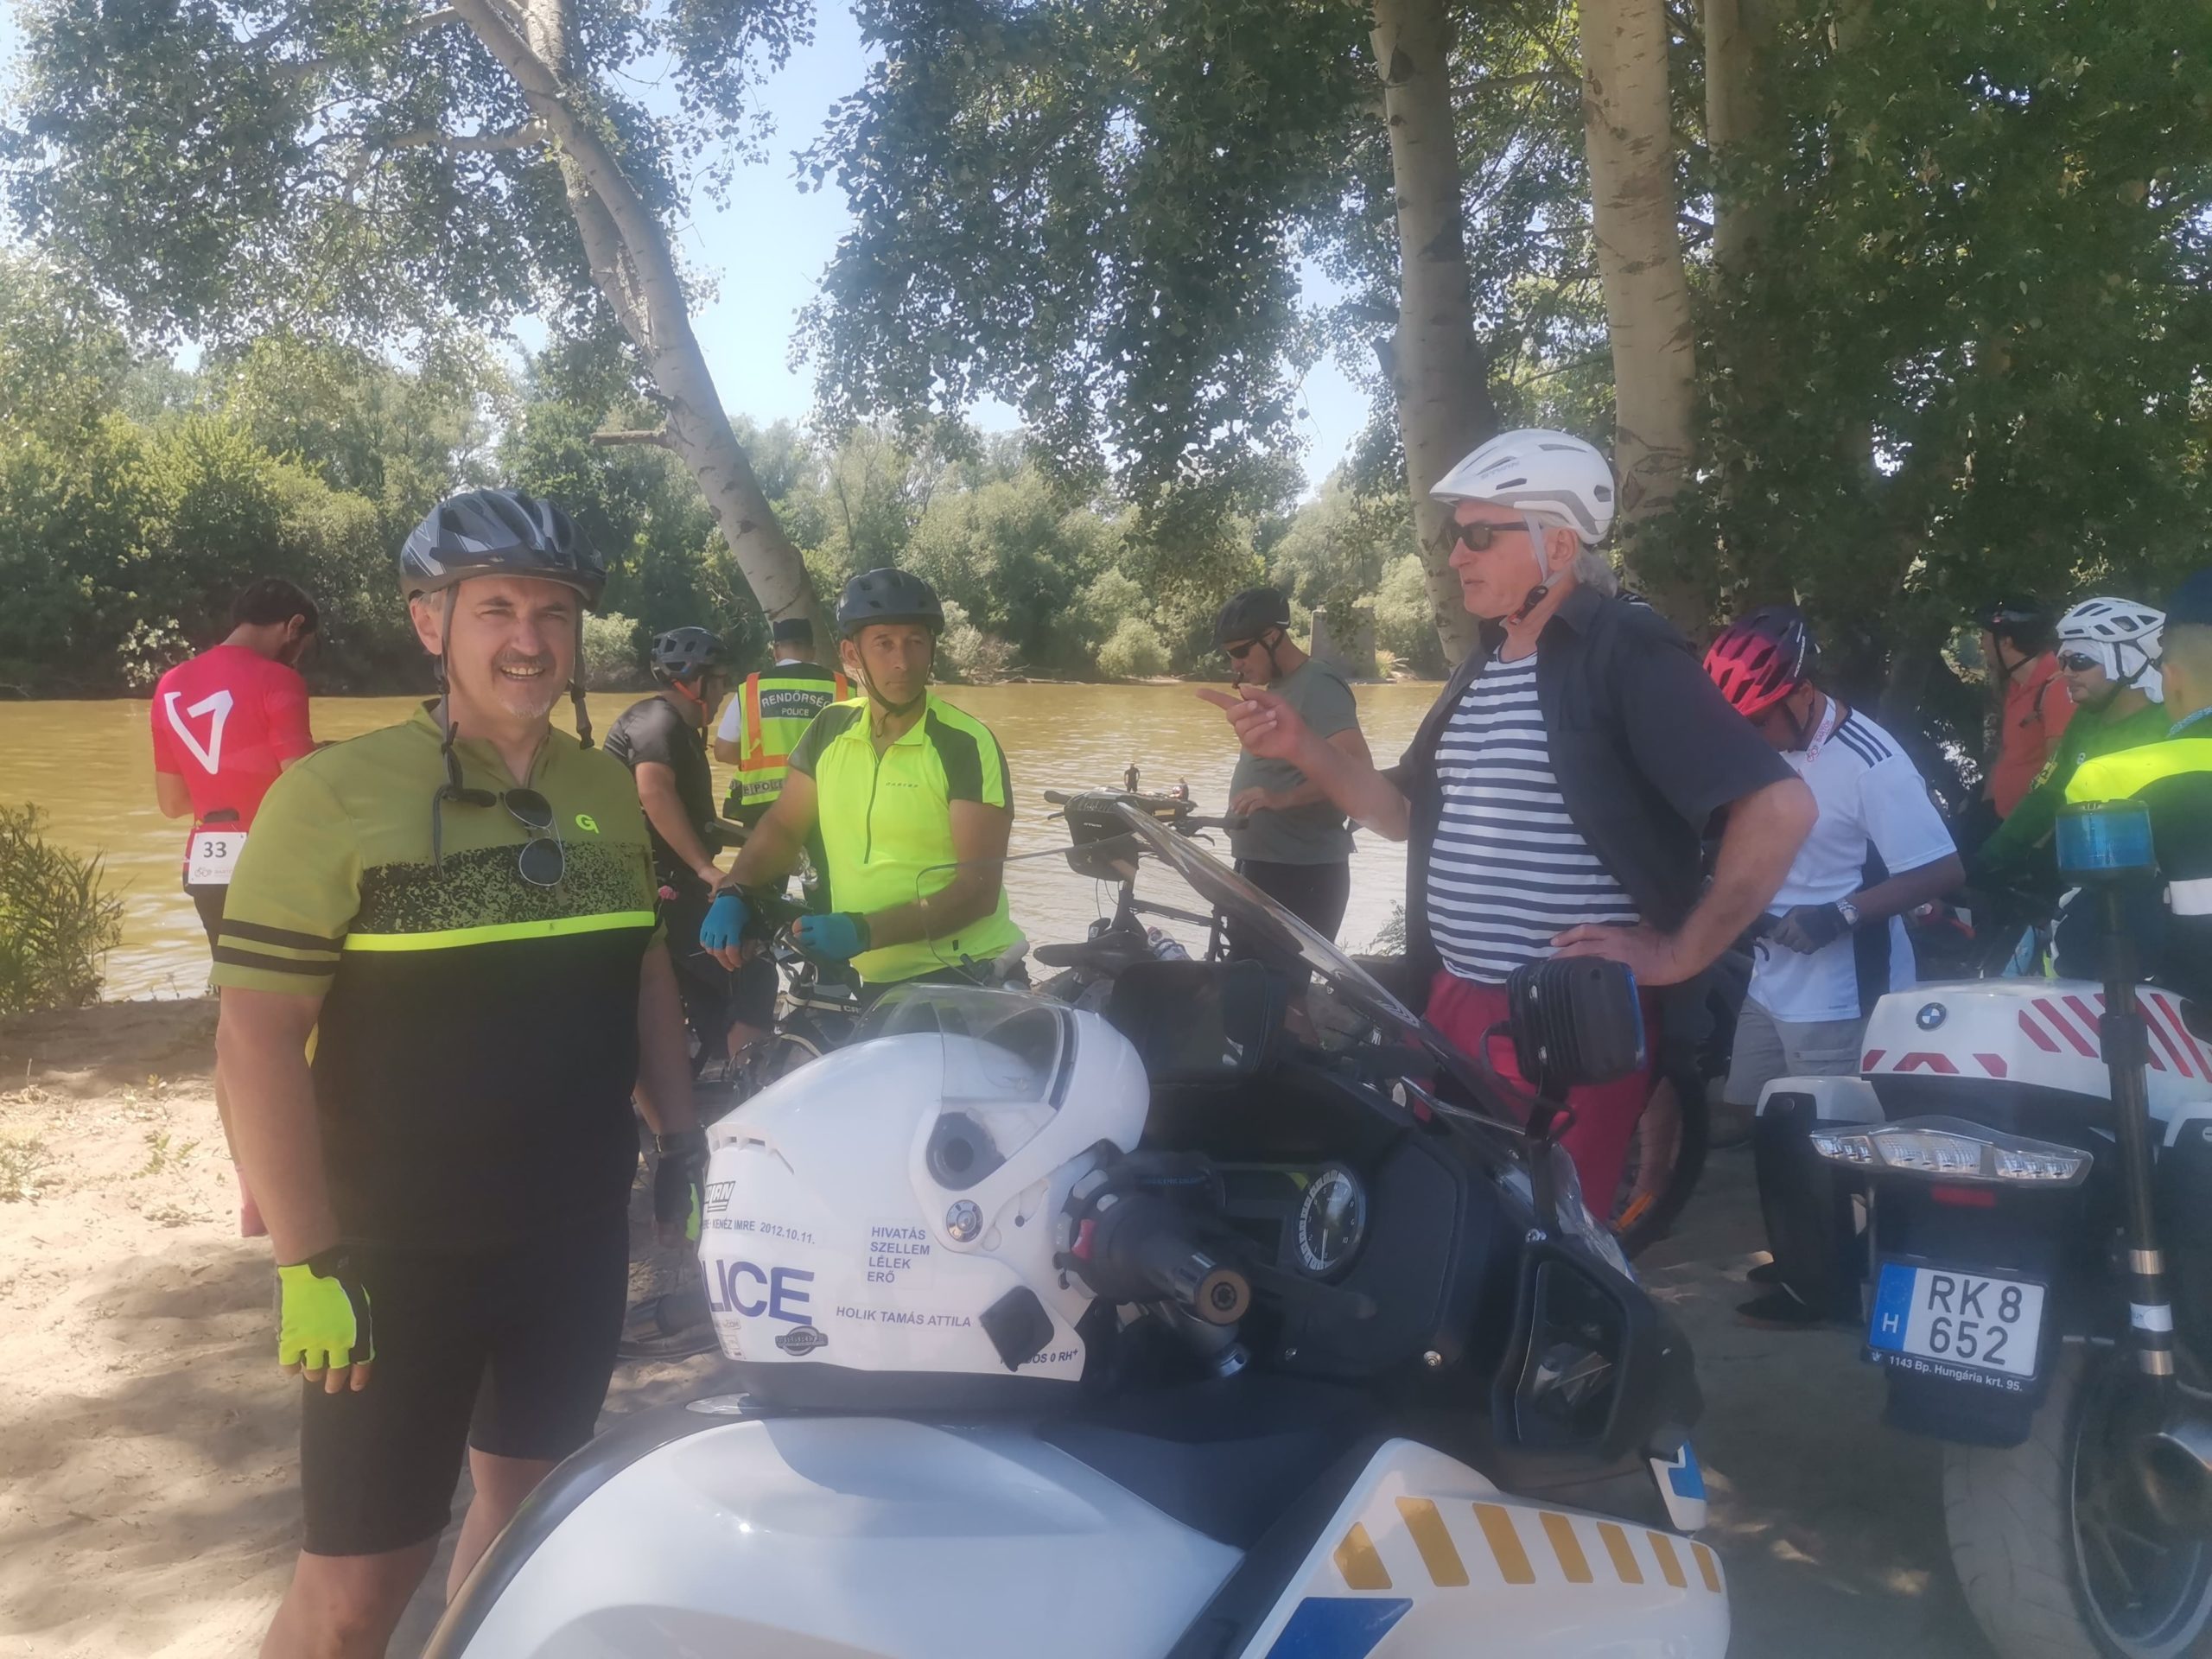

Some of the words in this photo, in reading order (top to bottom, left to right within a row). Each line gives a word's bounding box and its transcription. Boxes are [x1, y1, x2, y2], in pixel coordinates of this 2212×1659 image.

[781, 708, 809, 716] POLICE
[203, 842, 227, 858] 33
[705, 1180, 735, 1212] OLAN
[712, 1217, 733, 1230] KENÉZ
[734, 1220, 756, 1230] IMRE
[760, 1222, 815, 1244] 2012.10.11.
[871, 1226, 925, 1240] HIVATÁS
[870, 1242, 930, 1255] SZELLEM
[868, 1255, 912, 1269] LÉLEK
[867, 1270, 895, 1283] ERŐ
[702, 1259, 815, 1325] LICE
[836, 1306, 876, 1320] HOLIK
[880, 1311, 925, 1325] TAMÁS
[927, 1315, 971, 1326] ATTILA
[1881, 1313, 1899, 1333] H
[1929, 1316, 2008, 1366] 652
[1889, 1356, 1912, 1369] 1143
[1914, 1360, 1932, 1373] Bp.
[1934, 1364, 1983, 1382] Hungária
[1986, 1376, 2004, 1388] krt.
[2006, 1380, 2023, 1391] 95.
